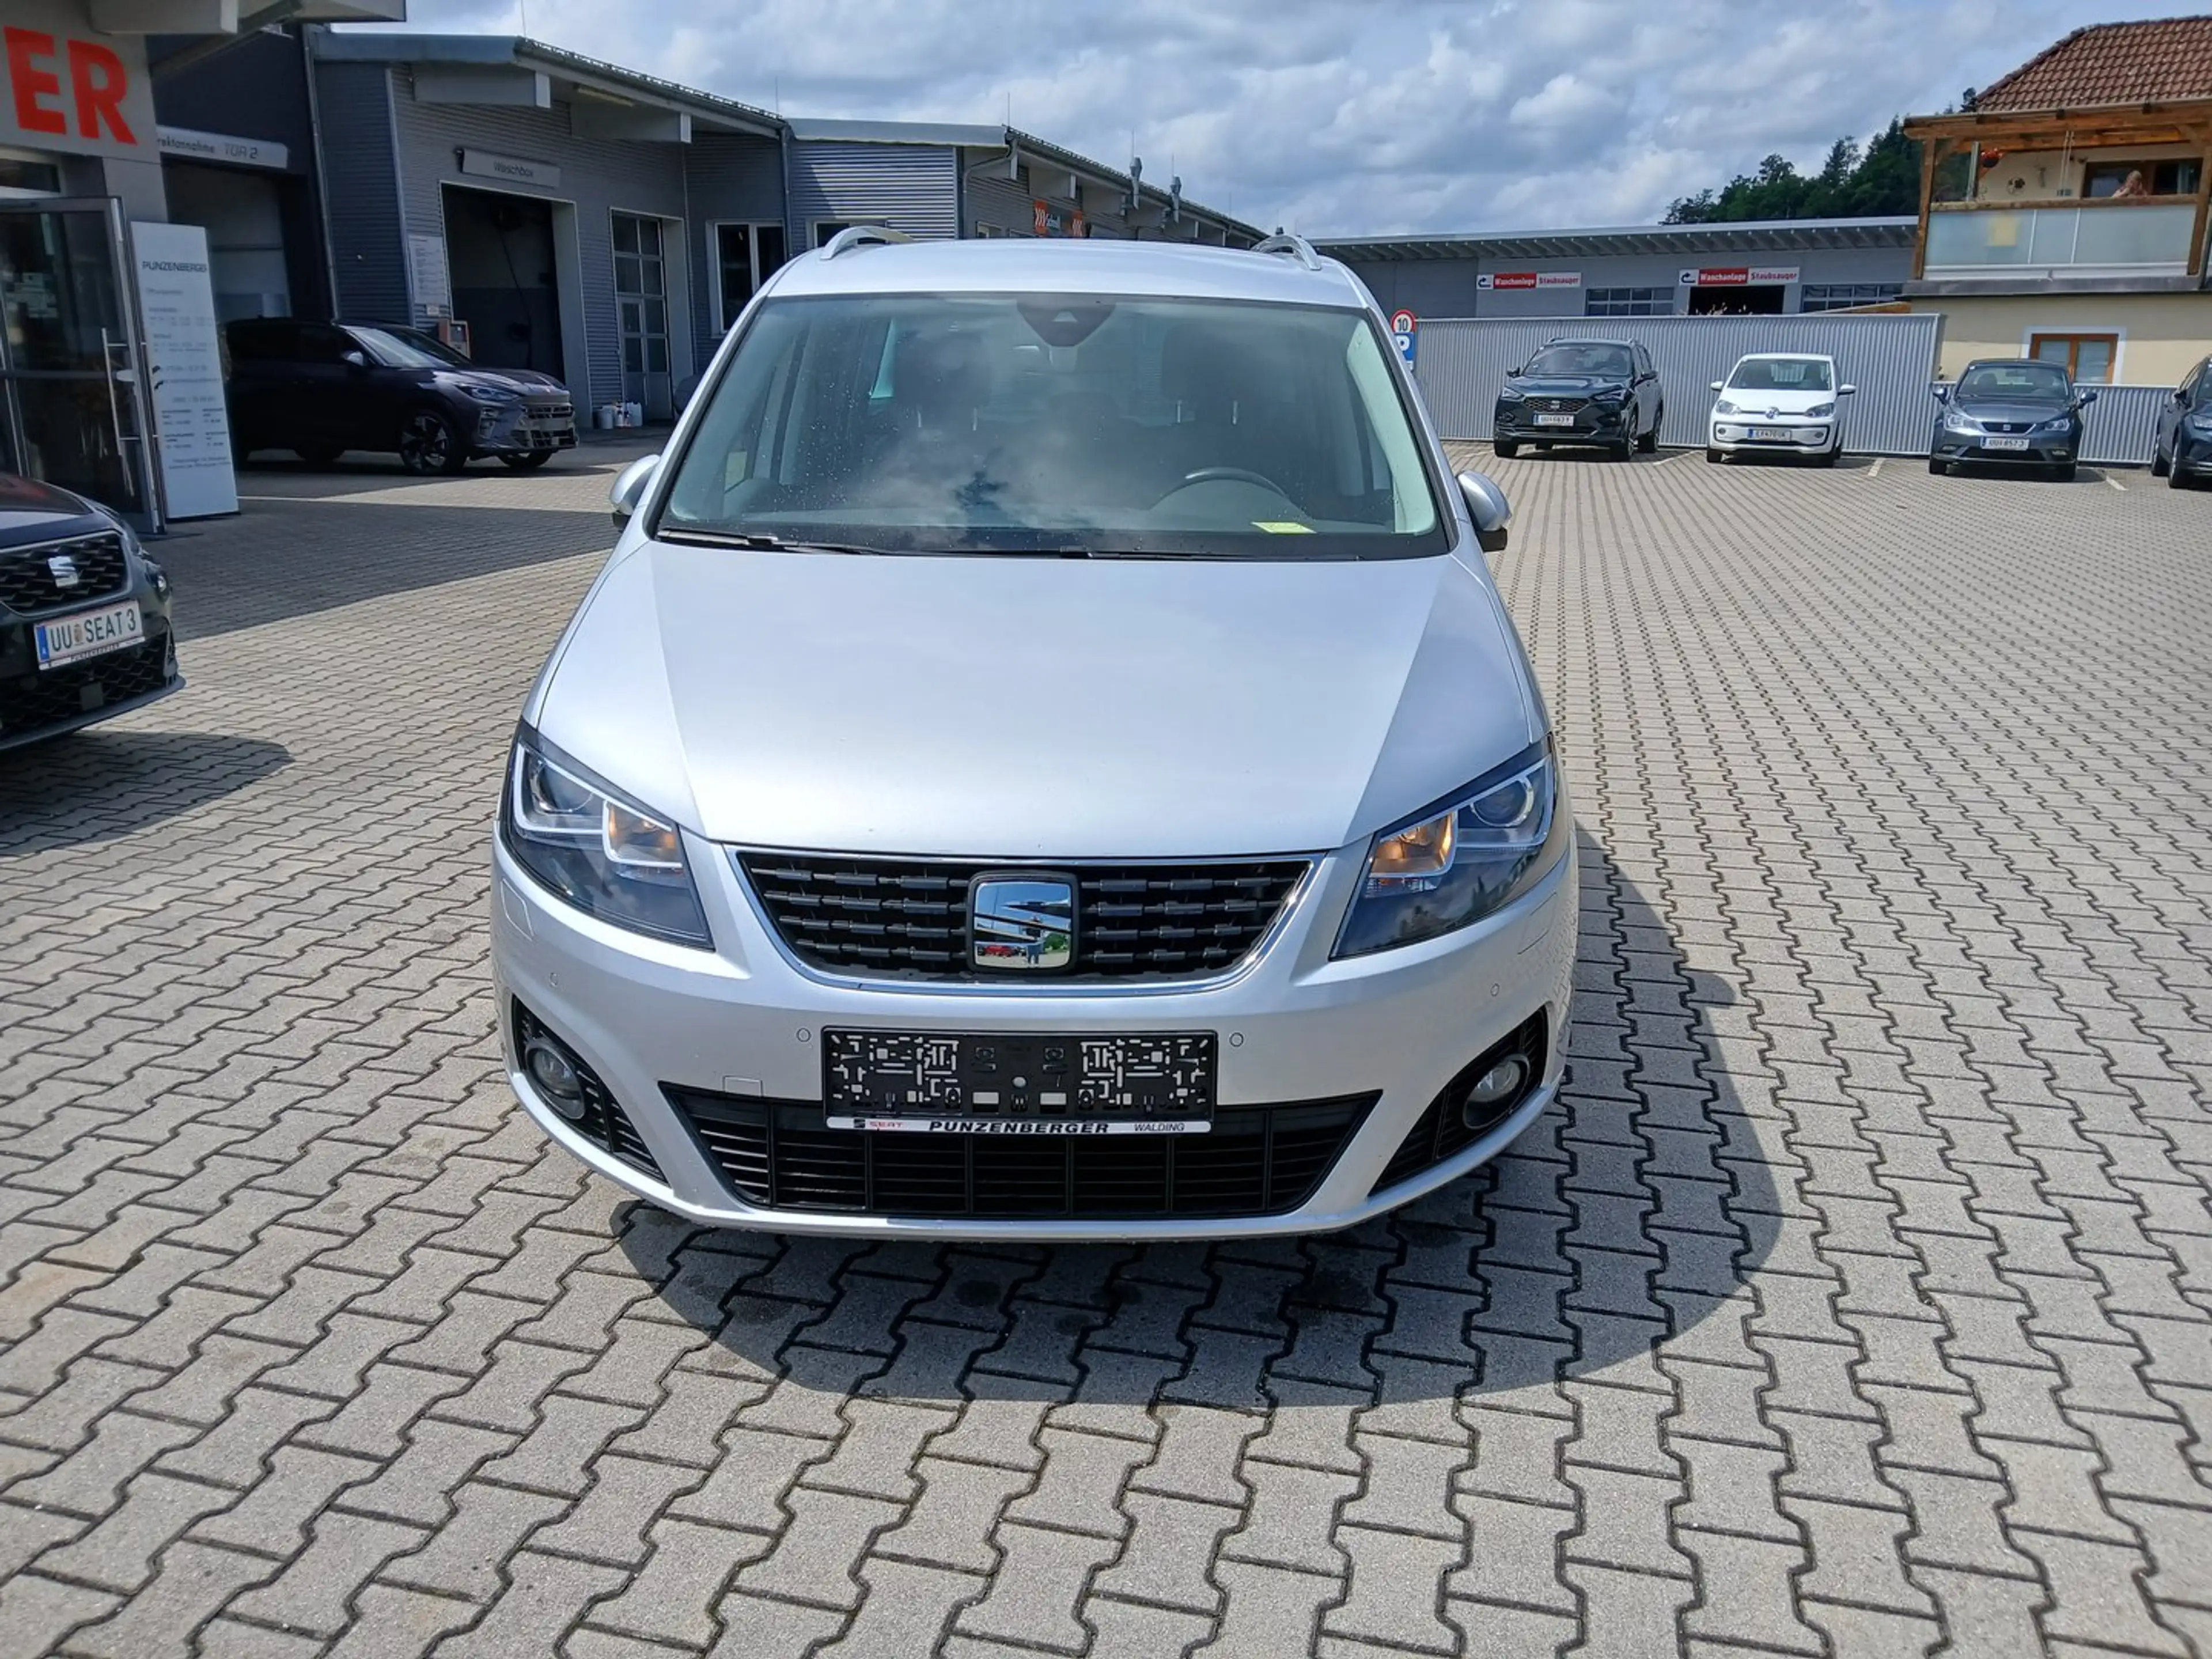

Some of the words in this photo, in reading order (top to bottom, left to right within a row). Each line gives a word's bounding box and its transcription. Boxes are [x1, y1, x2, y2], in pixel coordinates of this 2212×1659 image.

[3, 24, 138, 146] ER
[249, 147, 259, 160] 2
[493, 160, 534, 178] Waschbox
[1539, 276, 1579, 285] Staubsauger
[1699, 272, 1747, 282] Waschanlage
[1751, 272, 1797, 281] Staubsauger
[1397, 317, 1408, 332] 10
[50, 625, 73, 652] UU
[84, 611, 123, 643] SEAT
[126, 608, 137, 631] 3
[869, 1120, 903, 1128] SEAT
[928, 1120, 1110, 1135] PUNZENBERGER
[1132, 1123, 1185, 1132] WALDING
